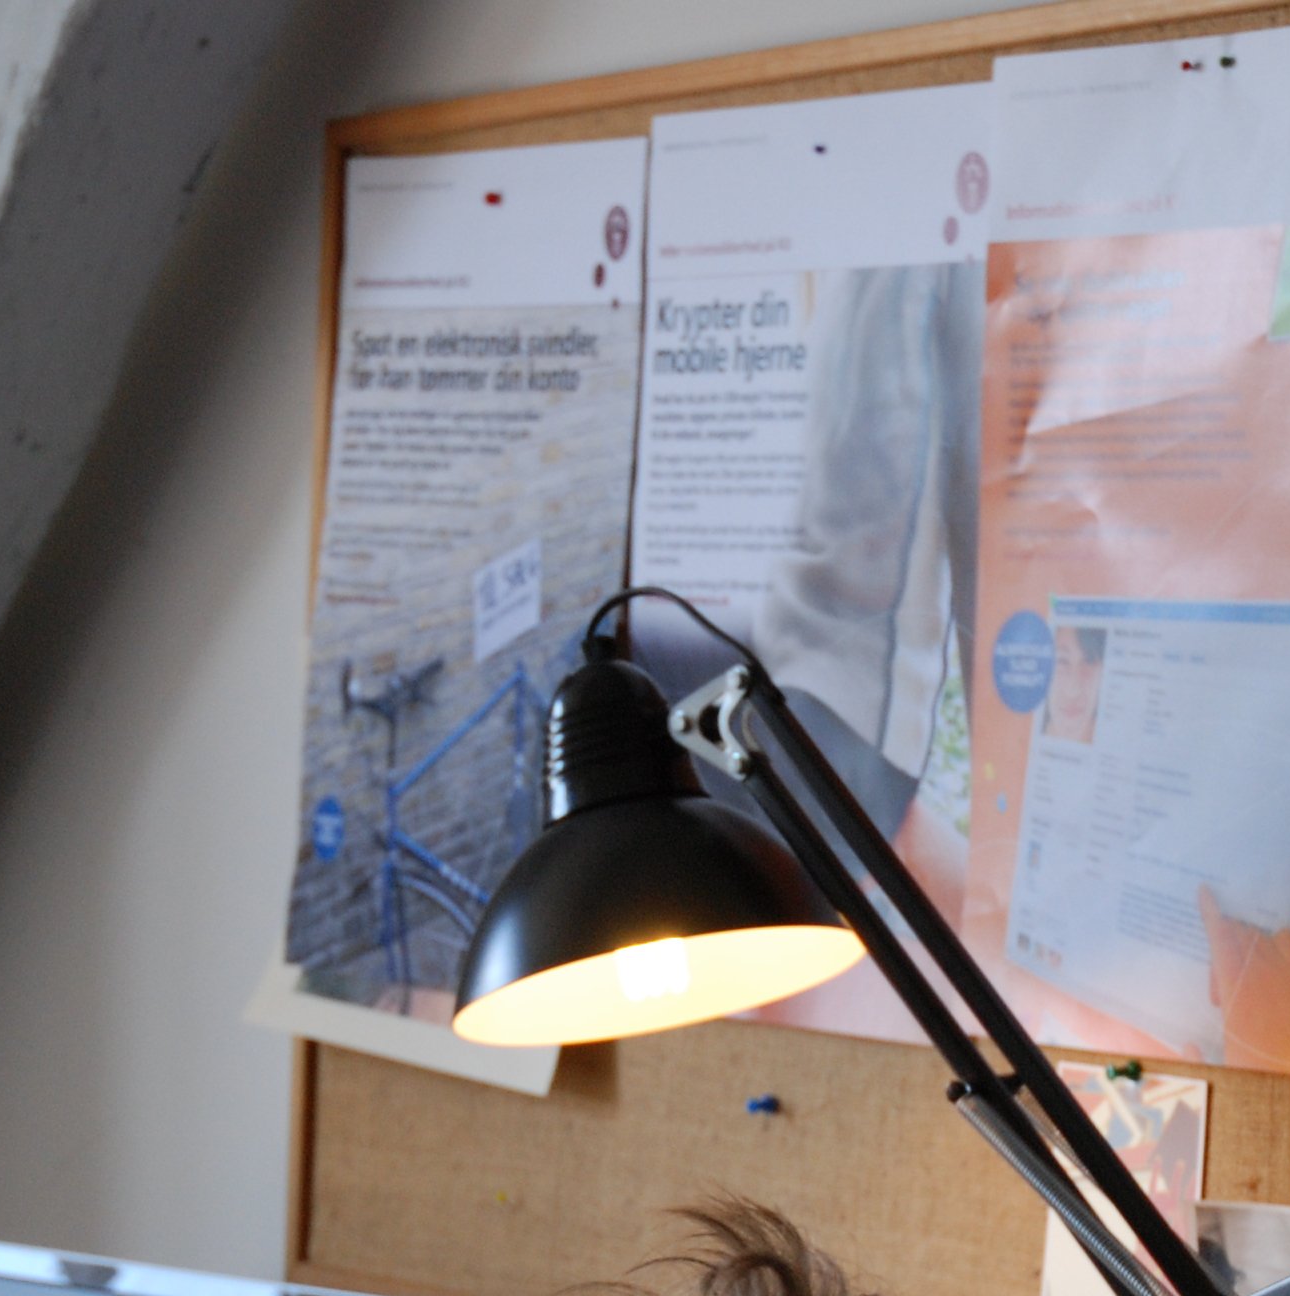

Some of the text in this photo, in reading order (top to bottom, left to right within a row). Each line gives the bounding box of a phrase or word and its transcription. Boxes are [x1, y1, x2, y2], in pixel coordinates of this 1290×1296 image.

[656, 288, 790, 342] Krypter din
[352, 328, 392, 360] Spot
[398, 334, 418, 356] en
[424, 328, 521, 357] elektronisk
[654, 334, 807, 383] mobile hjerne
[378, 361, 412, 390] han
[419, 366, 489, 392] tømmer
[494, 361, 523, 391] din
[528, 357, 581, 391] konto
